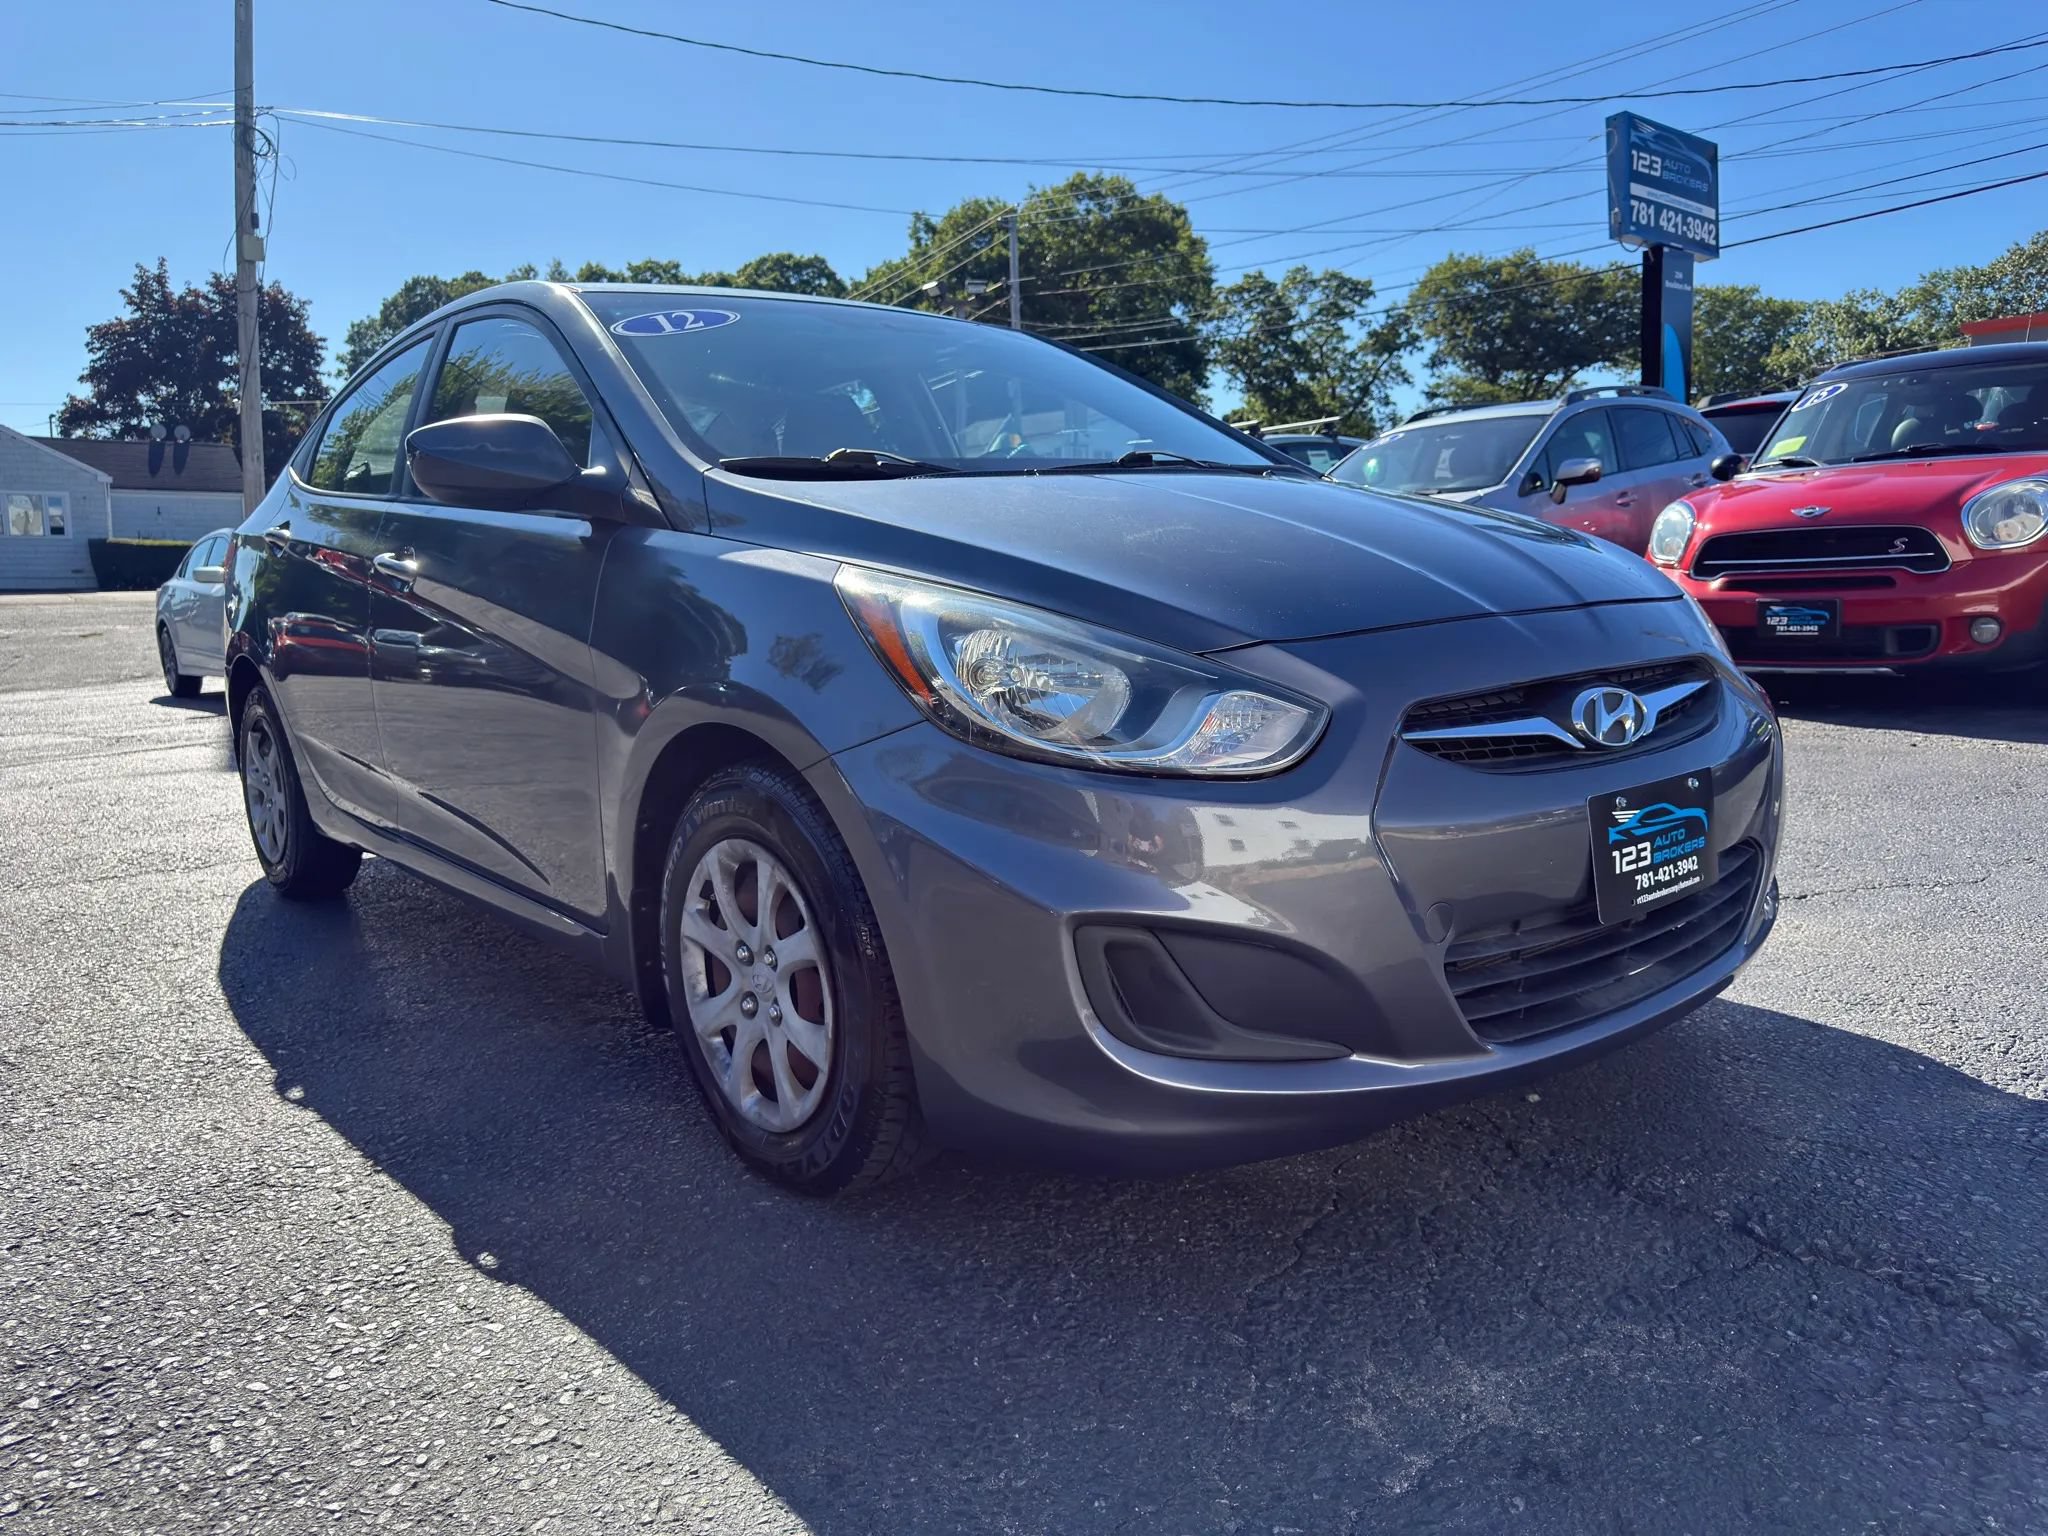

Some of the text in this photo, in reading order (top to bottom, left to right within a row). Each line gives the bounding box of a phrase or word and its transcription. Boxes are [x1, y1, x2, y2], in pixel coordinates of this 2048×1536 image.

[1630, 149, 1691, 177] 123 AUTO
[1630, 199, 1655, 227] 781
[1659, 208, 1716, 244] 421-3942
[649, 312, 704, 333] 12
[1766, 616, 1788, 625] 123
[1612, 828, 1686, 875] 123 AUTO
[1653, 836, 1705, 864] BROKERS
[1634, 855, 1699, 890] 781-421-3942
